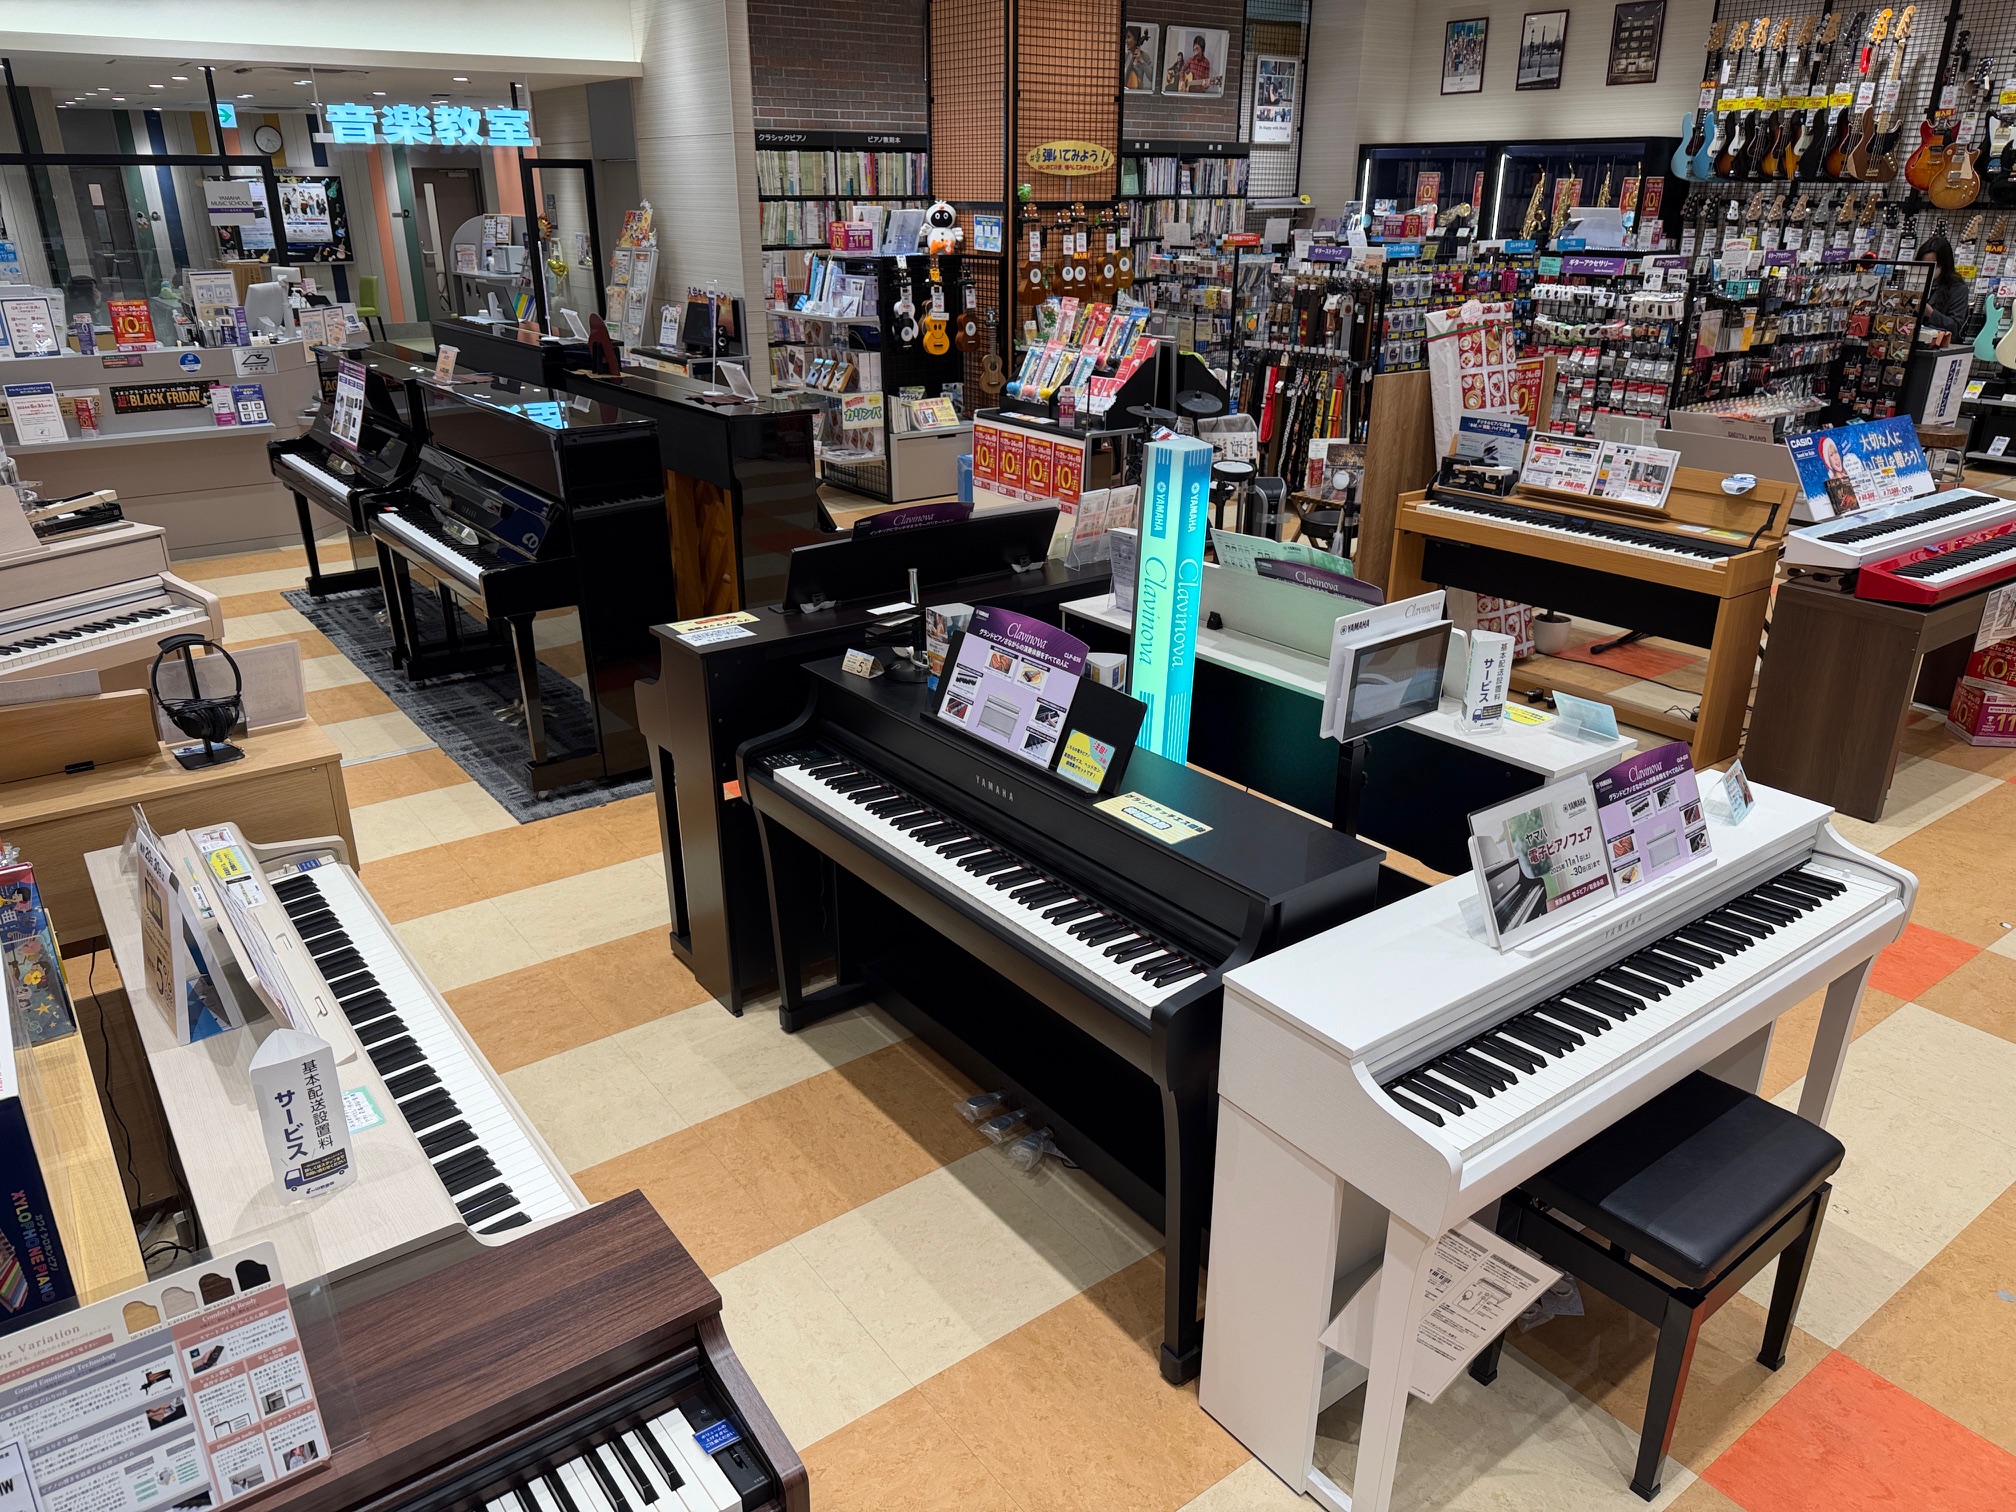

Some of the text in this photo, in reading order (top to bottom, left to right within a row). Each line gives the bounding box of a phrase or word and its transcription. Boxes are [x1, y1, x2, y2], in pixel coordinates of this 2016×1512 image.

[326, 102, 533, 146] 音楽教室
[758, 134, 807, 142] クラシックピアノ
[1042, 148, 1106, 163] 弾いてみよう!
[1314, 247, 1343, 255] ギターストラップ
[1568, 258, 1614, 268] ギターアクセサリー
[1655, 259, 1681, 267] ギターアクセサリー
[131, 394, 164, 407] BLACK
[167, 390, 201, 405] FRIDAY
[843, 405, 883, 422] カリンバ
[1727, 431, 1767, 443] DIGITAL PIANO
[1790, 437, 1813, 449] CASIO
[1860, 429, 1902, 453] 大切な人に
[1901, 484, 1914, 495] one
[893, 513, 935, 526] Clavinova
[1154, 494, 1165, 531] YAMAHA
[1188, 495, 1199, 533] YAMAHA
[1295, 571, 1339, 592] Clavinova
[1139, 556, 1168, 666] Clavinova
[1171, 558, 1199, 670] Clavinova
[1404, 601, 1441, 619] Clavinova
[1007, 622, 1048, 649] Clavinova
[1347, 619, 1370, 633] YAMAHA
[1478, 658, 1494, 703] サービス
[1494, 643, 1508, 701] 基本配送設置料
[1092, 740, 1108, 757] 注目!
[1628, 760, 1663, 783] Clavinova
[976, 775, 1014, 802] YAMAHA
[1568, 797, 1587, 811] YAMAHA
[1525, 827, 1548, 845] ヤマハ
[1528, 825, 1593, 864] 電子ピアノフェア
[1549, 852, 1591, 875] 2025年11月1日(土)
[2, 908, 17, 923] 曲
[1605, 913, 1644, 939] YAMAHA
[156, 955, 172, 996] 5%
[302, 1059, 333, 1150] 基本配送設置料
[274, 1090, 308, 1160] サービス
[11, 1190, 56, 1302] XYLOPHONE PIANO
[35, 1214, 59, 1271] カワイ シロホンピアノ
[202, 1309, 229, 1323] Comfort
[237, 1297, 257, 1309] Ready
[17, 1325, 81, 1354] Variation
[14, 1382, 39, 1396] Grand
[40, 1365, 76, 1387] Emotional
[76, 1351, 118, 1372] Technology
[267, 1405, 311, 1427] コンサートマジック
